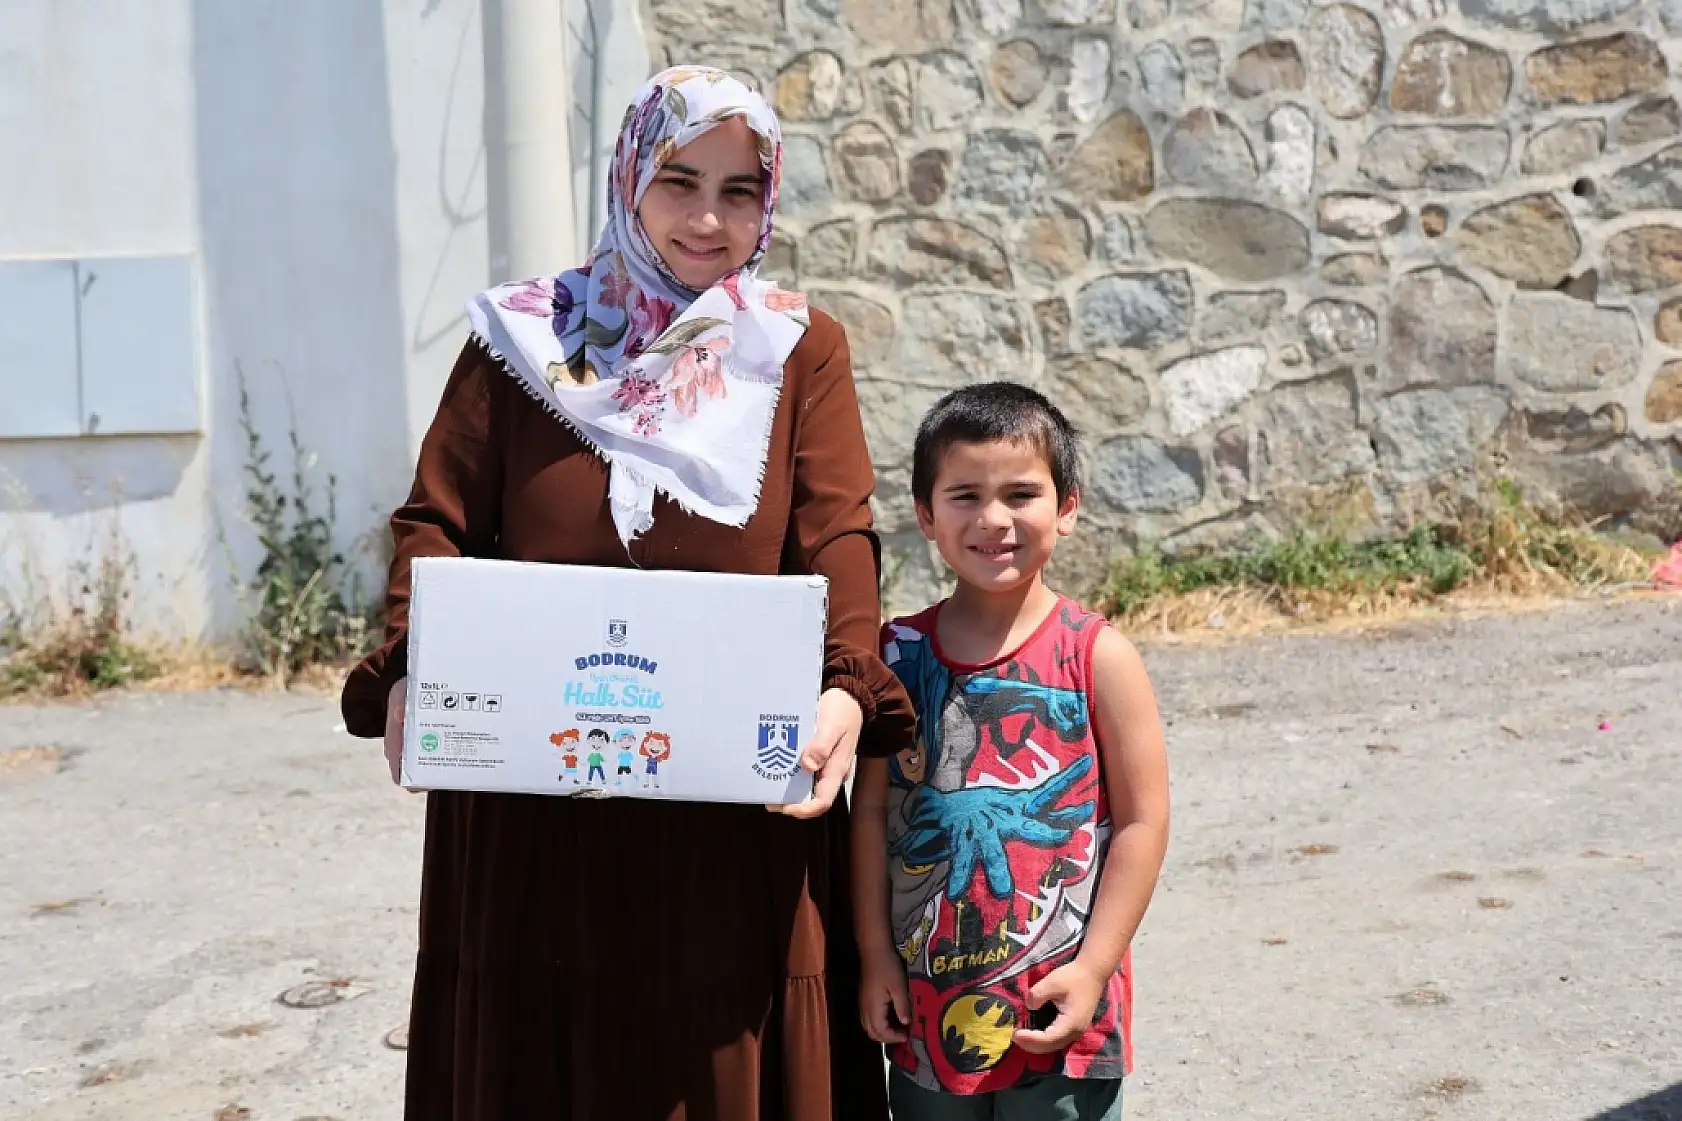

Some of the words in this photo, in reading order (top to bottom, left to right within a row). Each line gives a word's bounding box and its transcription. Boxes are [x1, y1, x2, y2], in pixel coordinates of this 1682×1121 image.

[575, 653, 657, 674] BODRUM
[564, 681, 618, 706] Halk
[622, 684, 664, 708] Süt
[759, 713, 800, 721] BODRUM
[933, 943, 1010, 975] BATMAN
